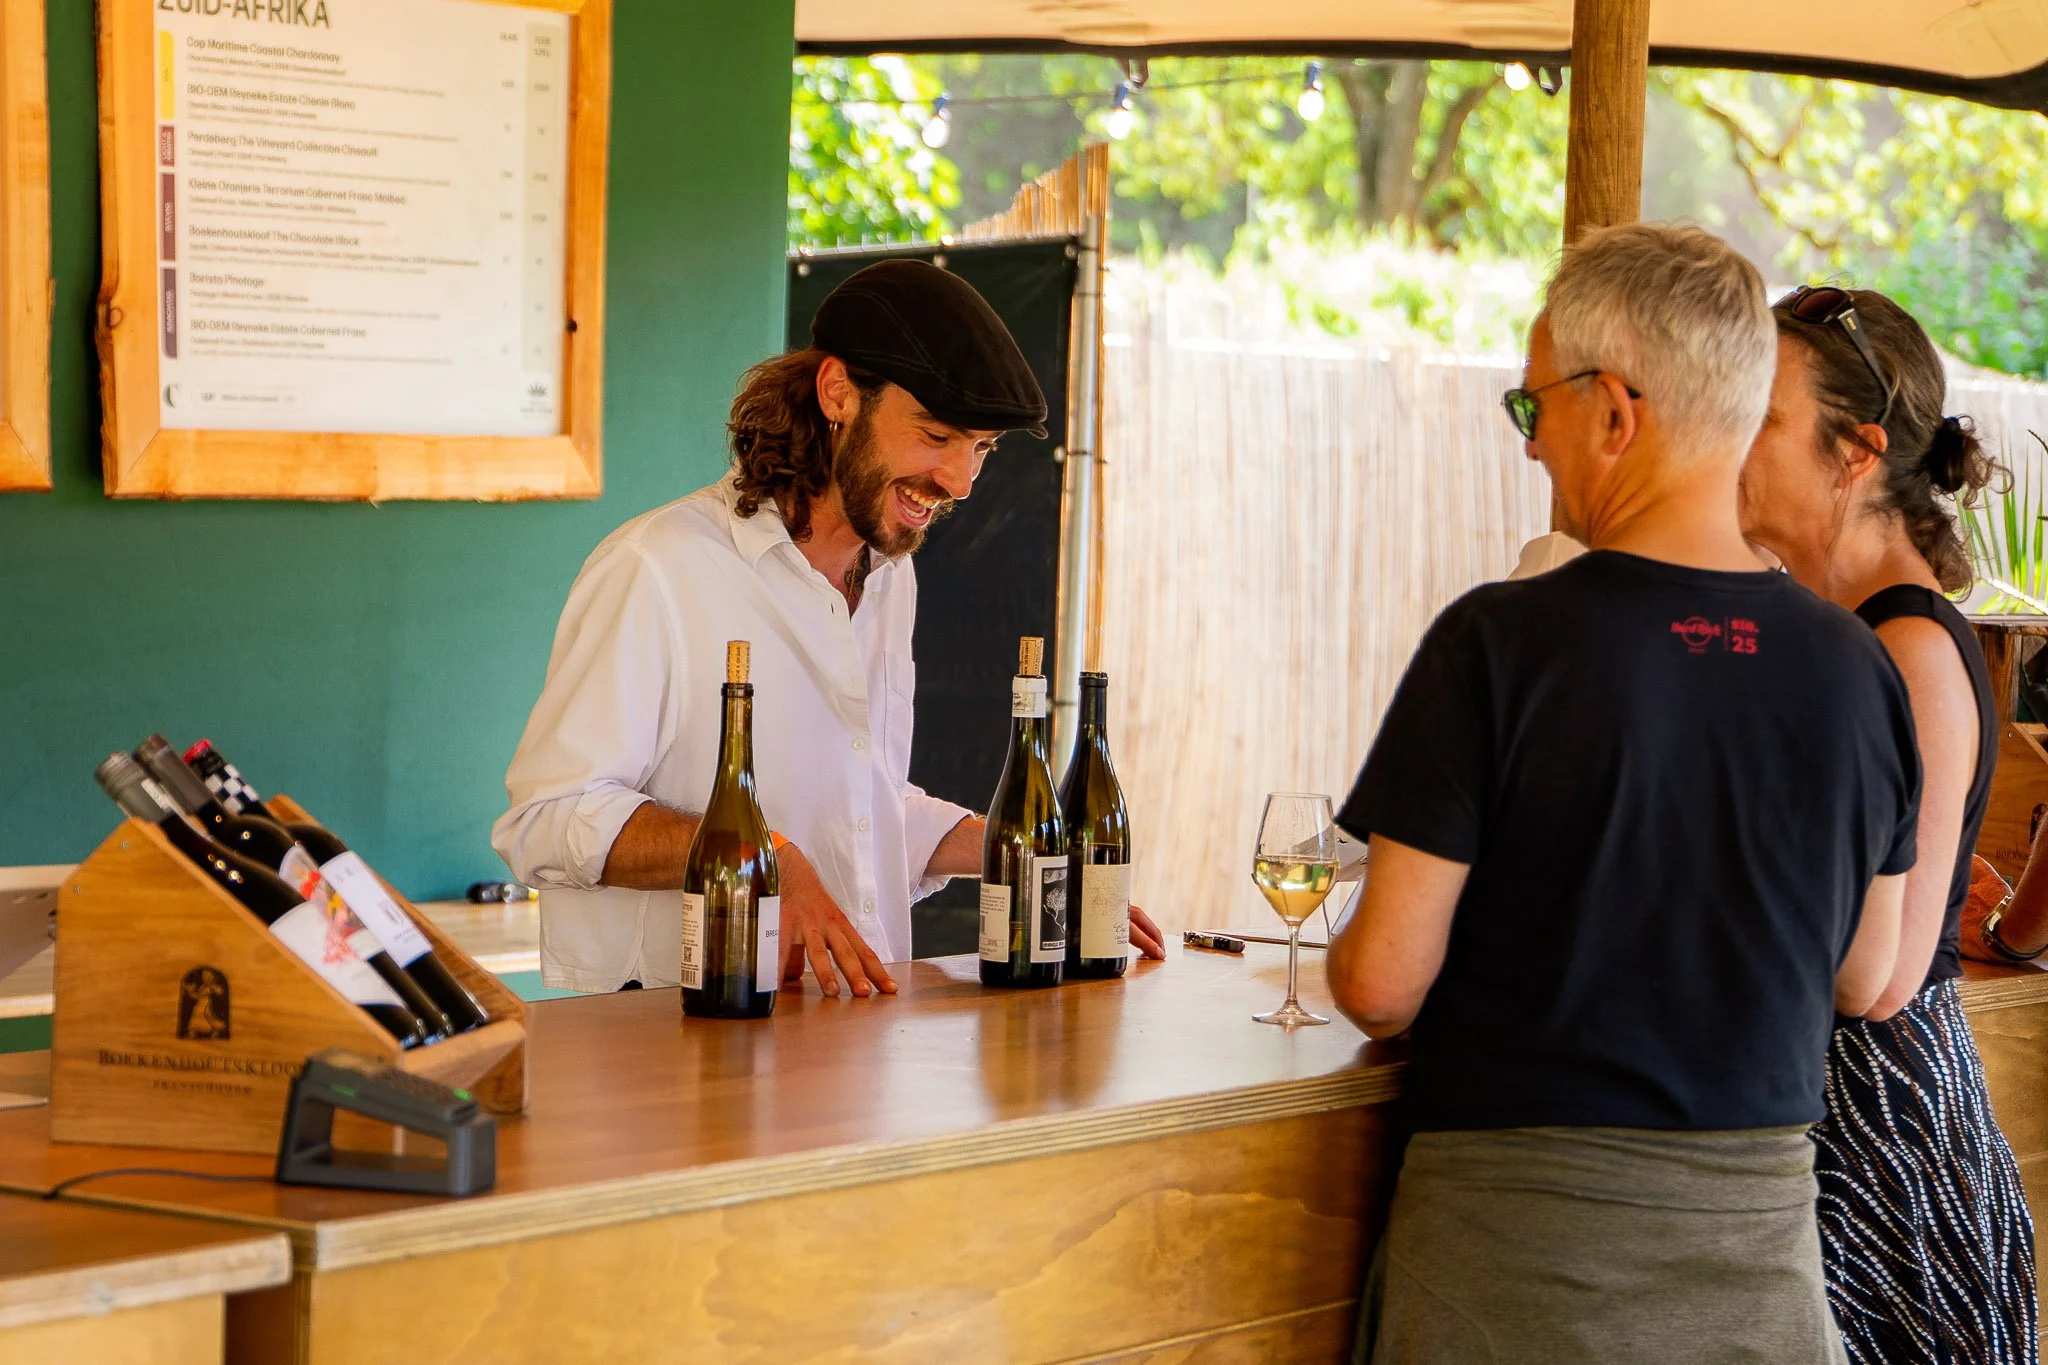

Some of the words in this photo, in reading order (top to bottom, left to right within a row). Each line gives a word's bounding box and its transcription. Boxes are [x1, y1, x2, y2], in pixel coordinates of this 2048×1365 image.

[187, 36, 206, 50] Cap
[207, 38, 249, 53] Maritime
[250, 42, 285, 57] Coastal
[286, 46, 341, 64] Chardonnay
[269, 92, 298, 105] Estate
[300, 95, 330, 108] Chenin
[256, 136, 296, 152] Vineyard
[297, 140, 341, 155] Collection
[306, 186, 347, 201] Cabernet
[349, 189, 373, 204] Franc
[291, 231, 334, 246] Chocolate
[189, 271, 223, 285] Barista
[224, 273, 264, 289] Pinotage
[1731, 634, 1758, 654] 25
[99, 1048, 303, 1079] BOEKENHOUTSKLOO
